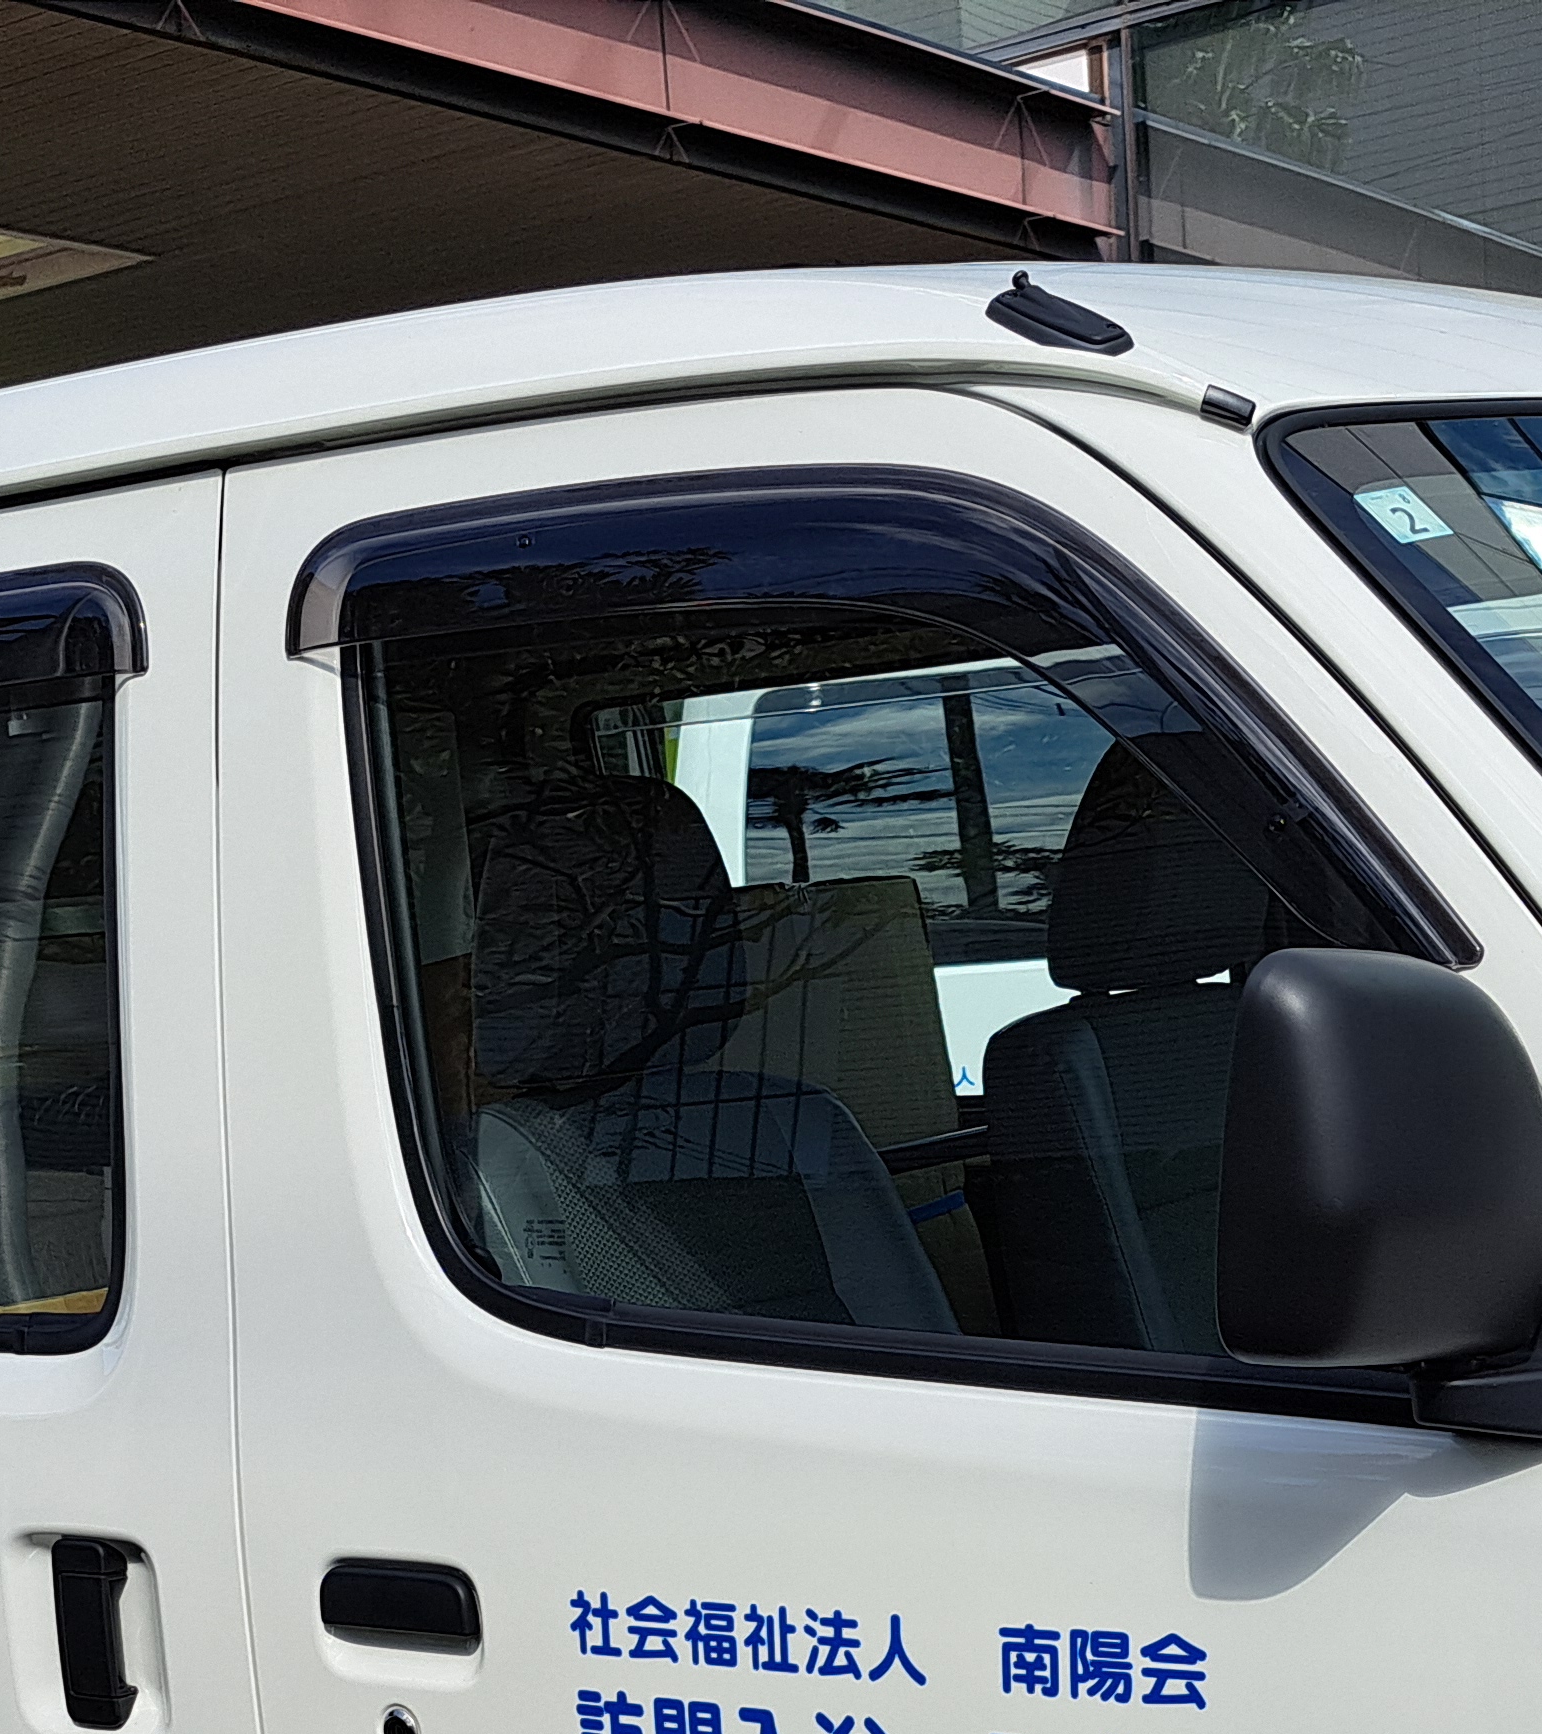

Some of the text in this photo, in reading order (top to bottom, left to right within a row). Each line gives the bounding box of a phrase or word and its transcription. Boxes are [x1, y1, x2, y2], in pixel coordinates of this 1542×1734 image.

[1389, 506, 1431, 535] 2
[568, 1589, 1209, 1711] 社会福祉法人 南陽会
